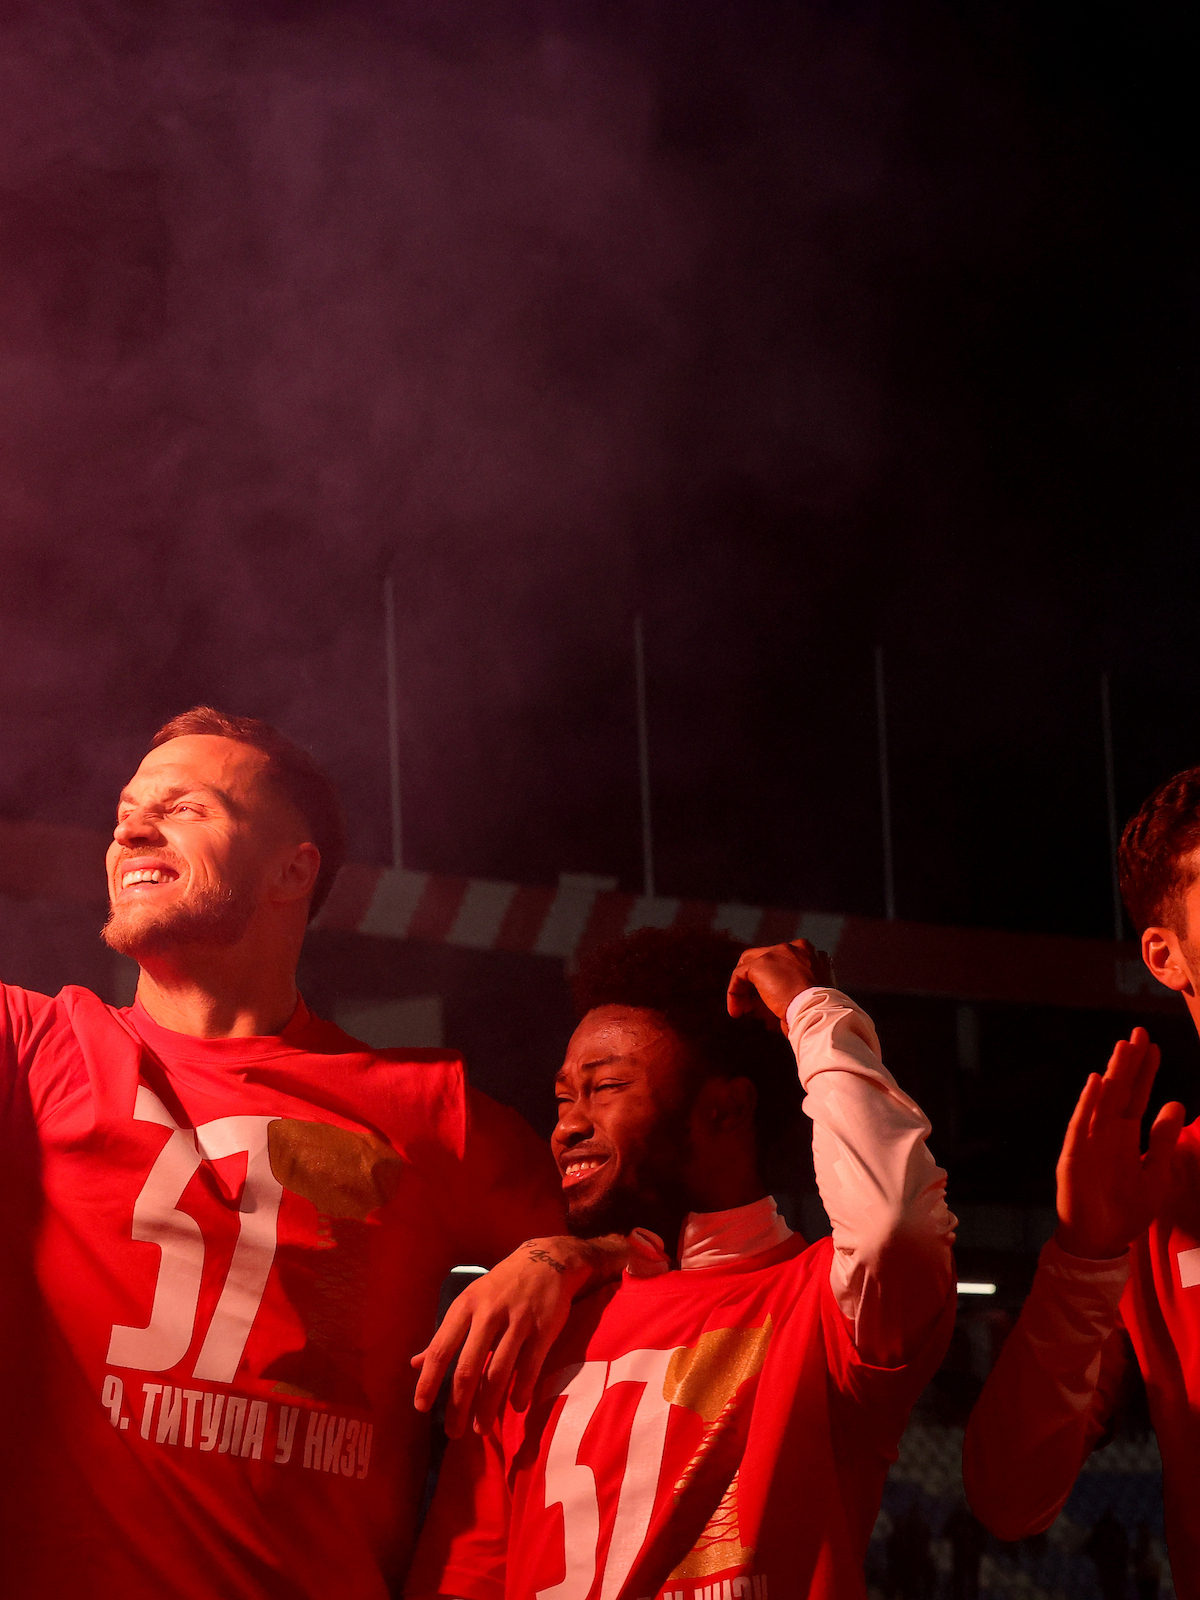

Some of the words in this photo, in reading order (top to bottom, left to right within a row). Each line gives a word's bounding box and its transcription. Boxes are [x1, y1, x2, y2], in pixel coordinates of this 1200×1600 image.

[106, 1084, 284, 1383] 37
[101, 1376, 129, 1429] 9.
[140, 1383, 268, 1460] ТИТУЛА
[275, 1405, 298, 1465] У
[304, 1413, 374, 1480] НИЗУ
